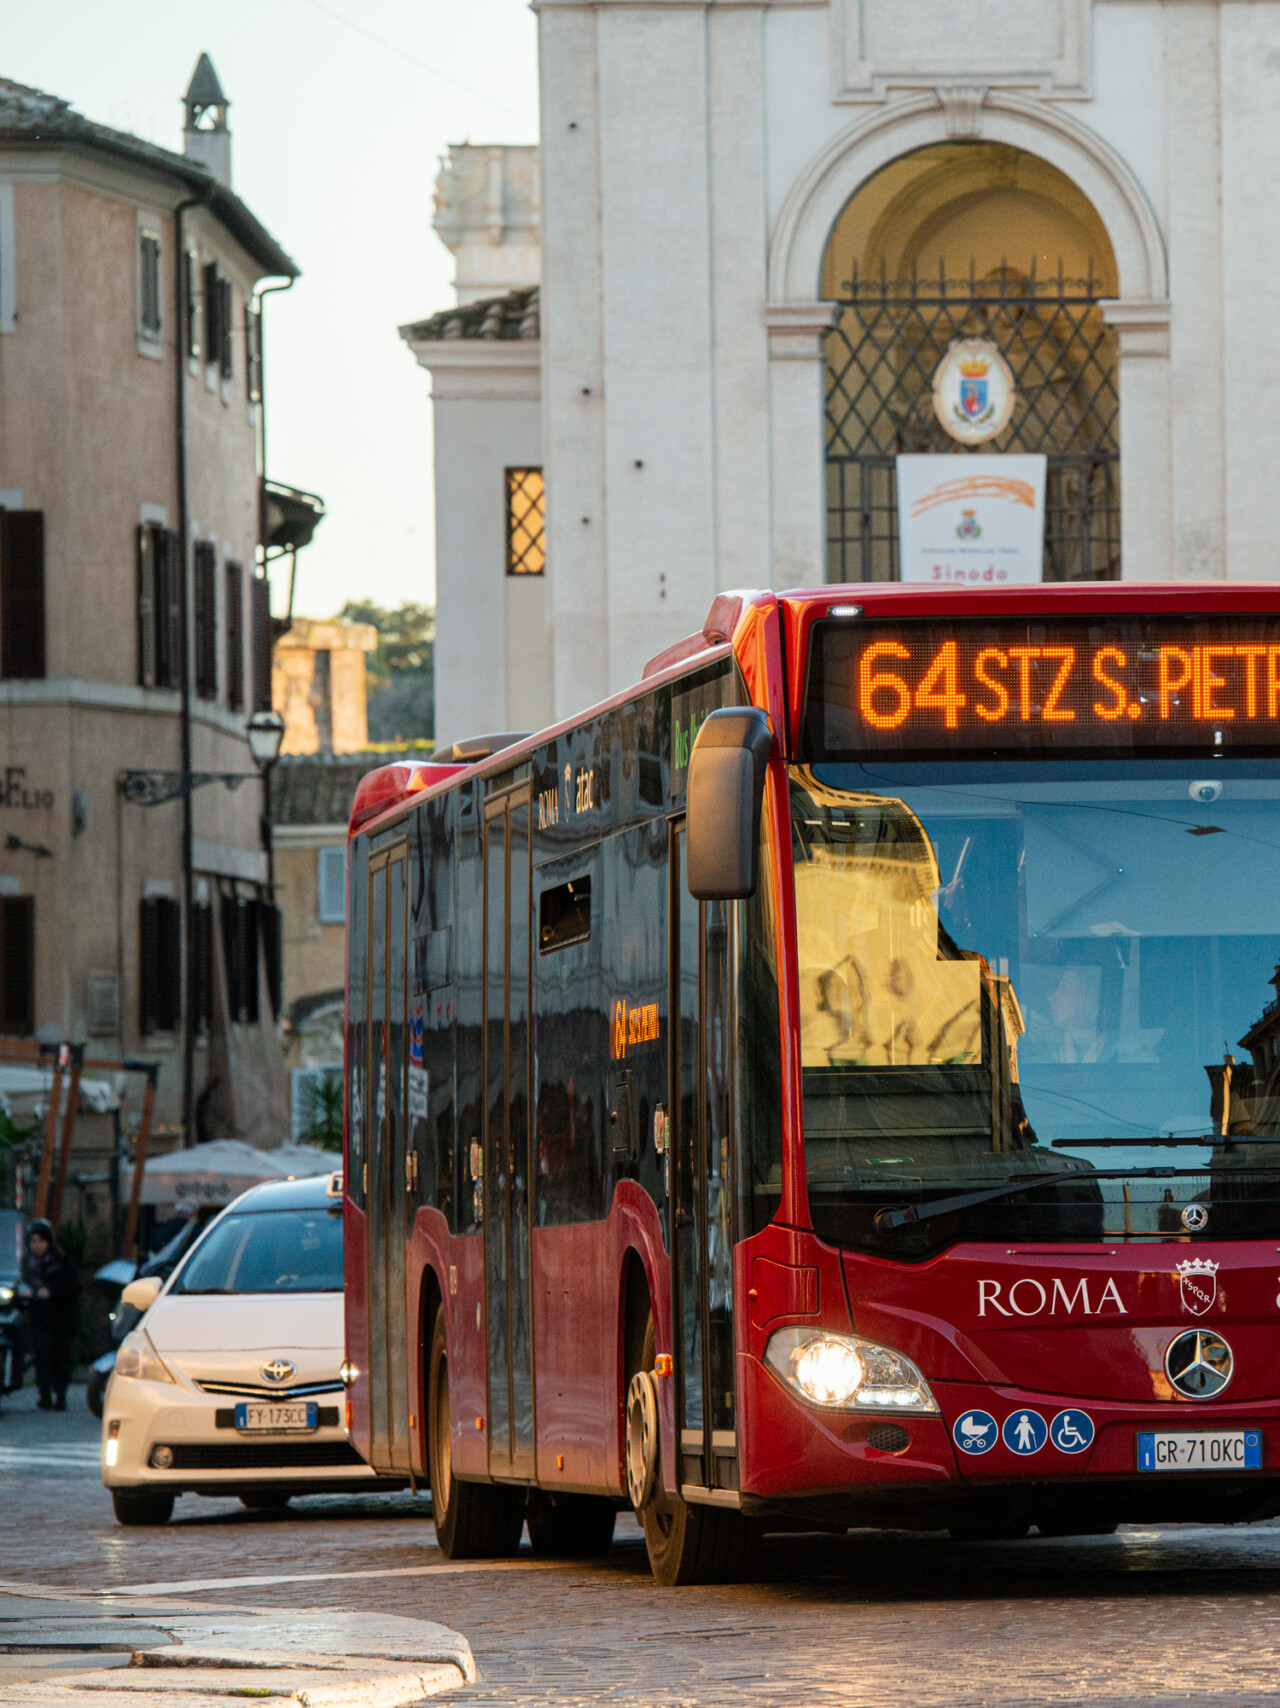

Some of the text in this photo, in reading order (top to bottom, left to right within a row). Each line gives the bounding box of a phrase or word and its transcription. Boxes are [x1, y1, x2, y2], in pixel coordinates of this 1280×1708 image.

[932, 564, 1008, 581] Sinodo
[860, 641, 966, 728] 64
[975, 646, 1076, 721] STZ
[1093, 647, 1141, 720] S.
[576, 766, 594, 815] atac
[977, 1277, 1128, 1316] ROMA
